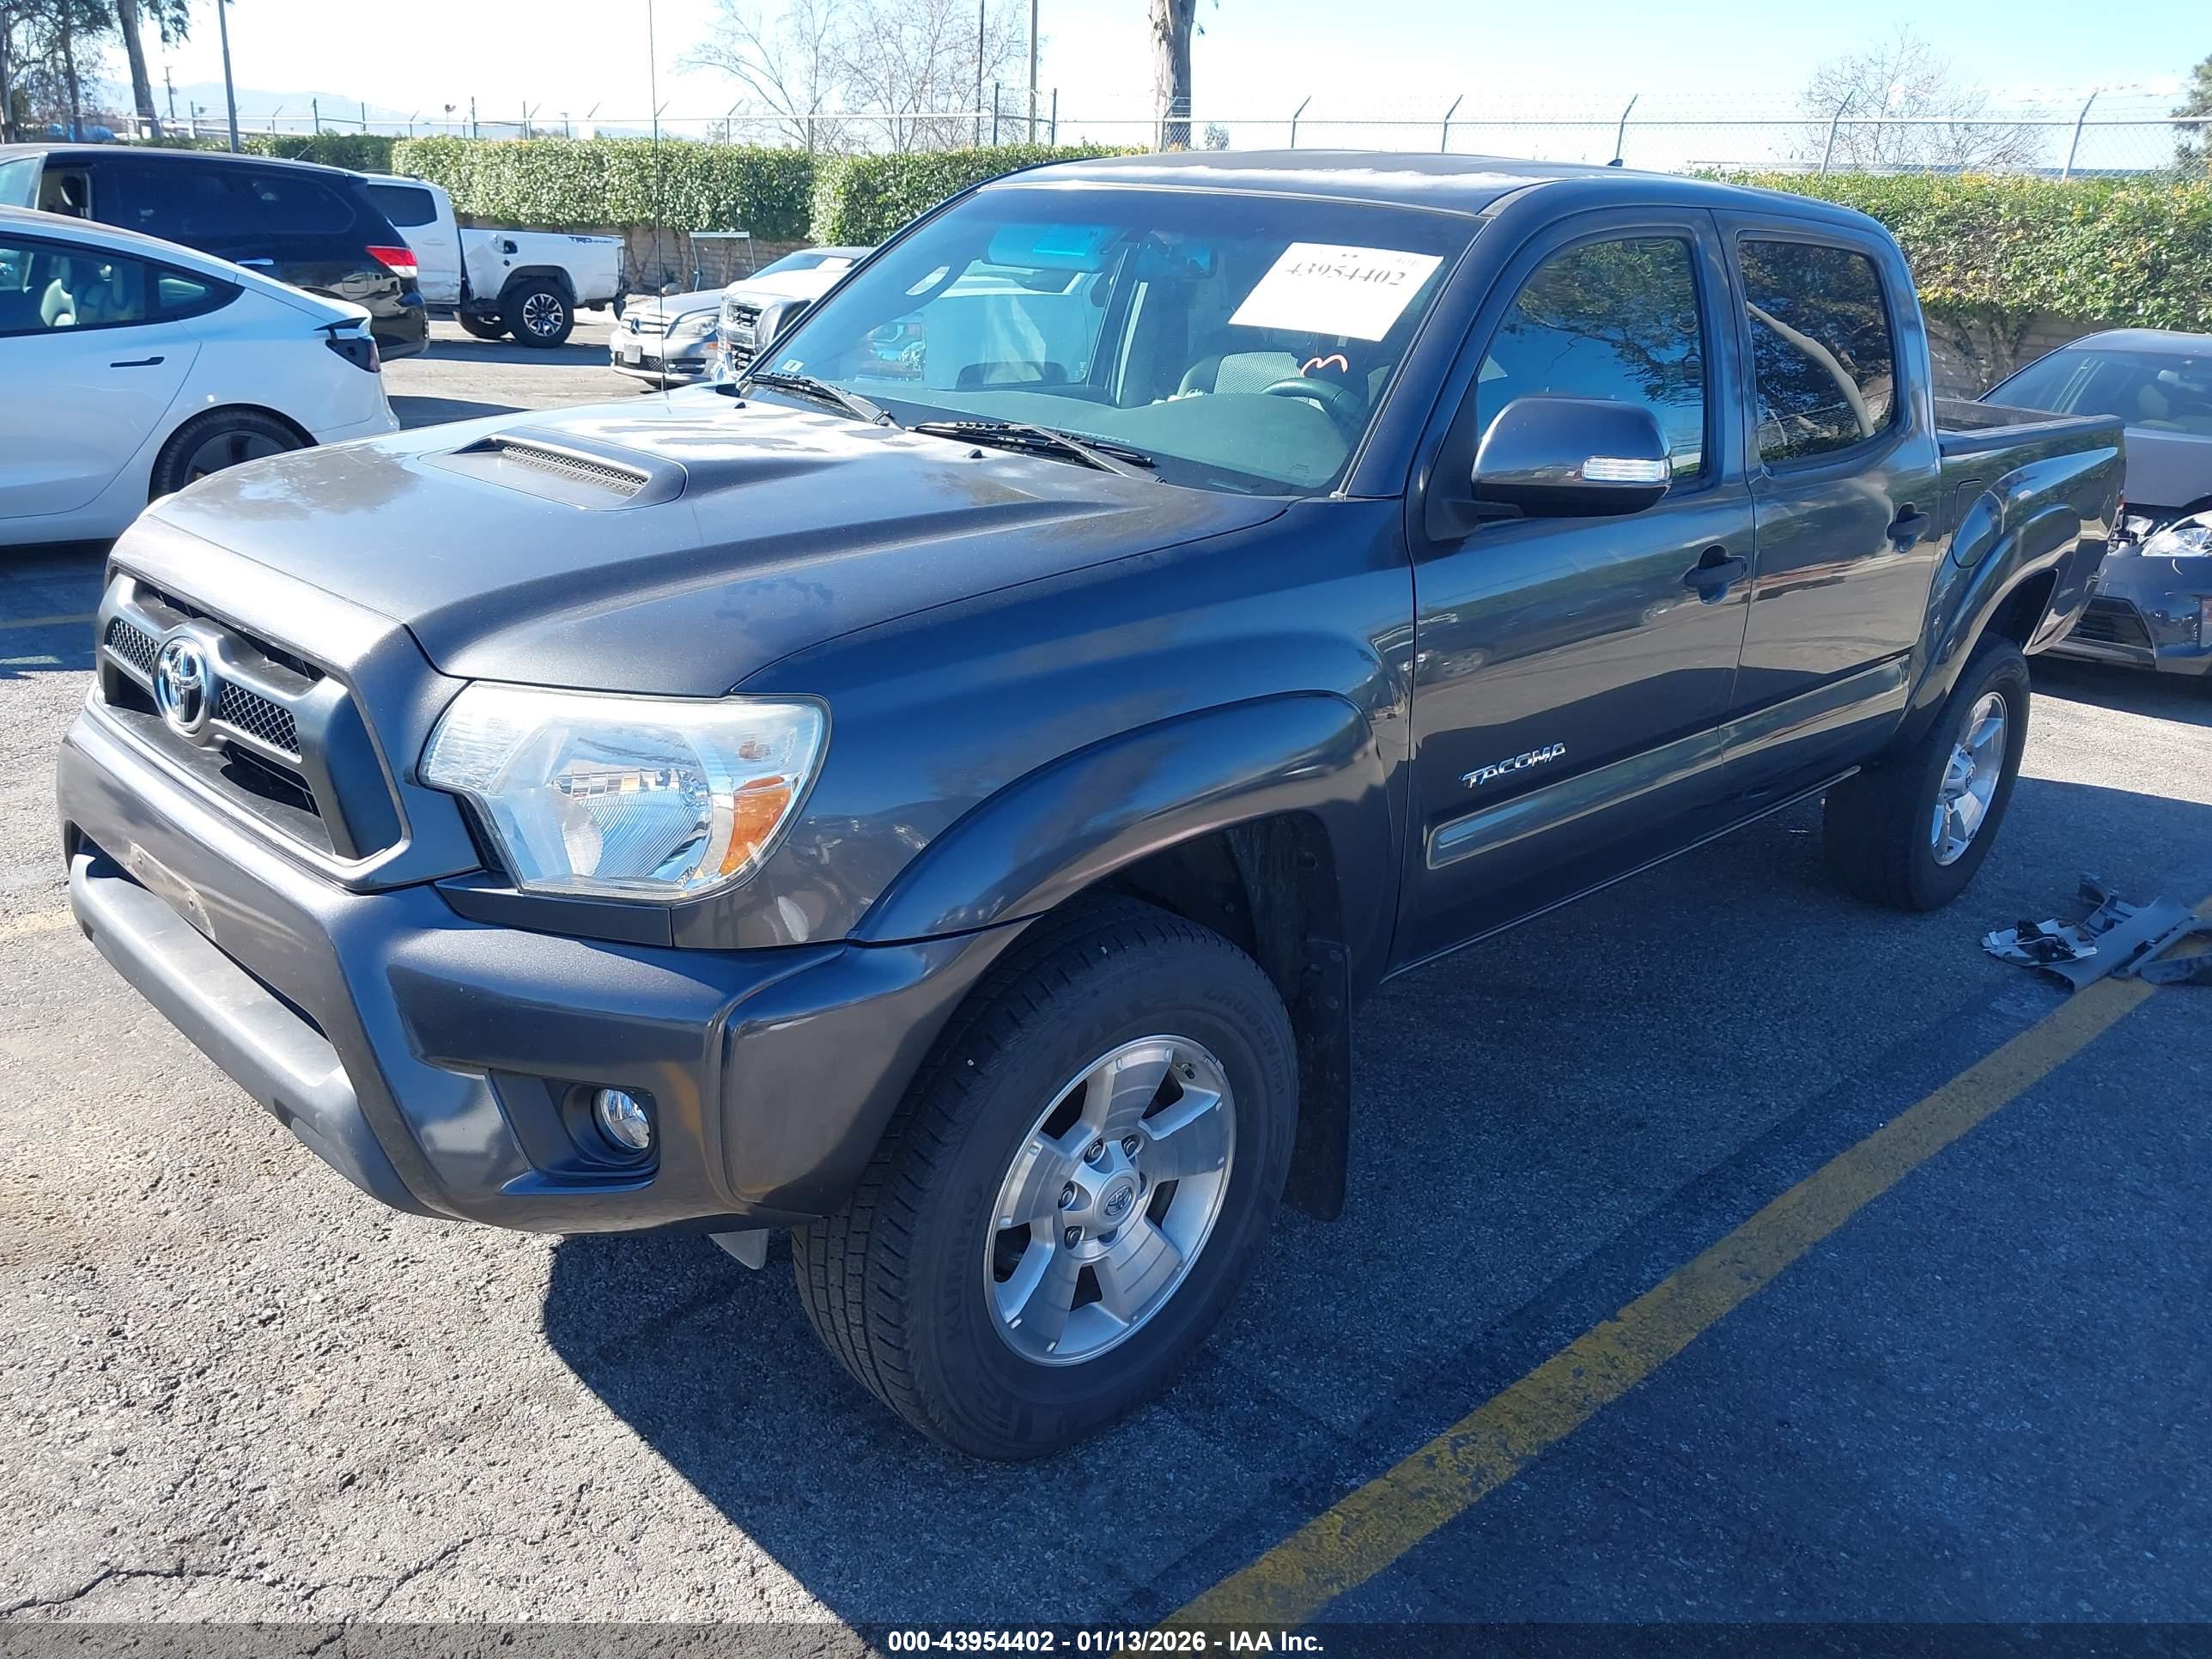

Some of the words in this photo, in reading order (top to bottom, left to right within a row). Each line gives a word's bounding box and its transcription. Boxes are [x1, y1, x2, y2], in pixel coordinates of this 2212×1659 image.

[1286, 262, 1407, 286] 43954402
[1462, 742, 1566, 789] TACOMA
[943, 1182, 984, 1345] KUMHO
